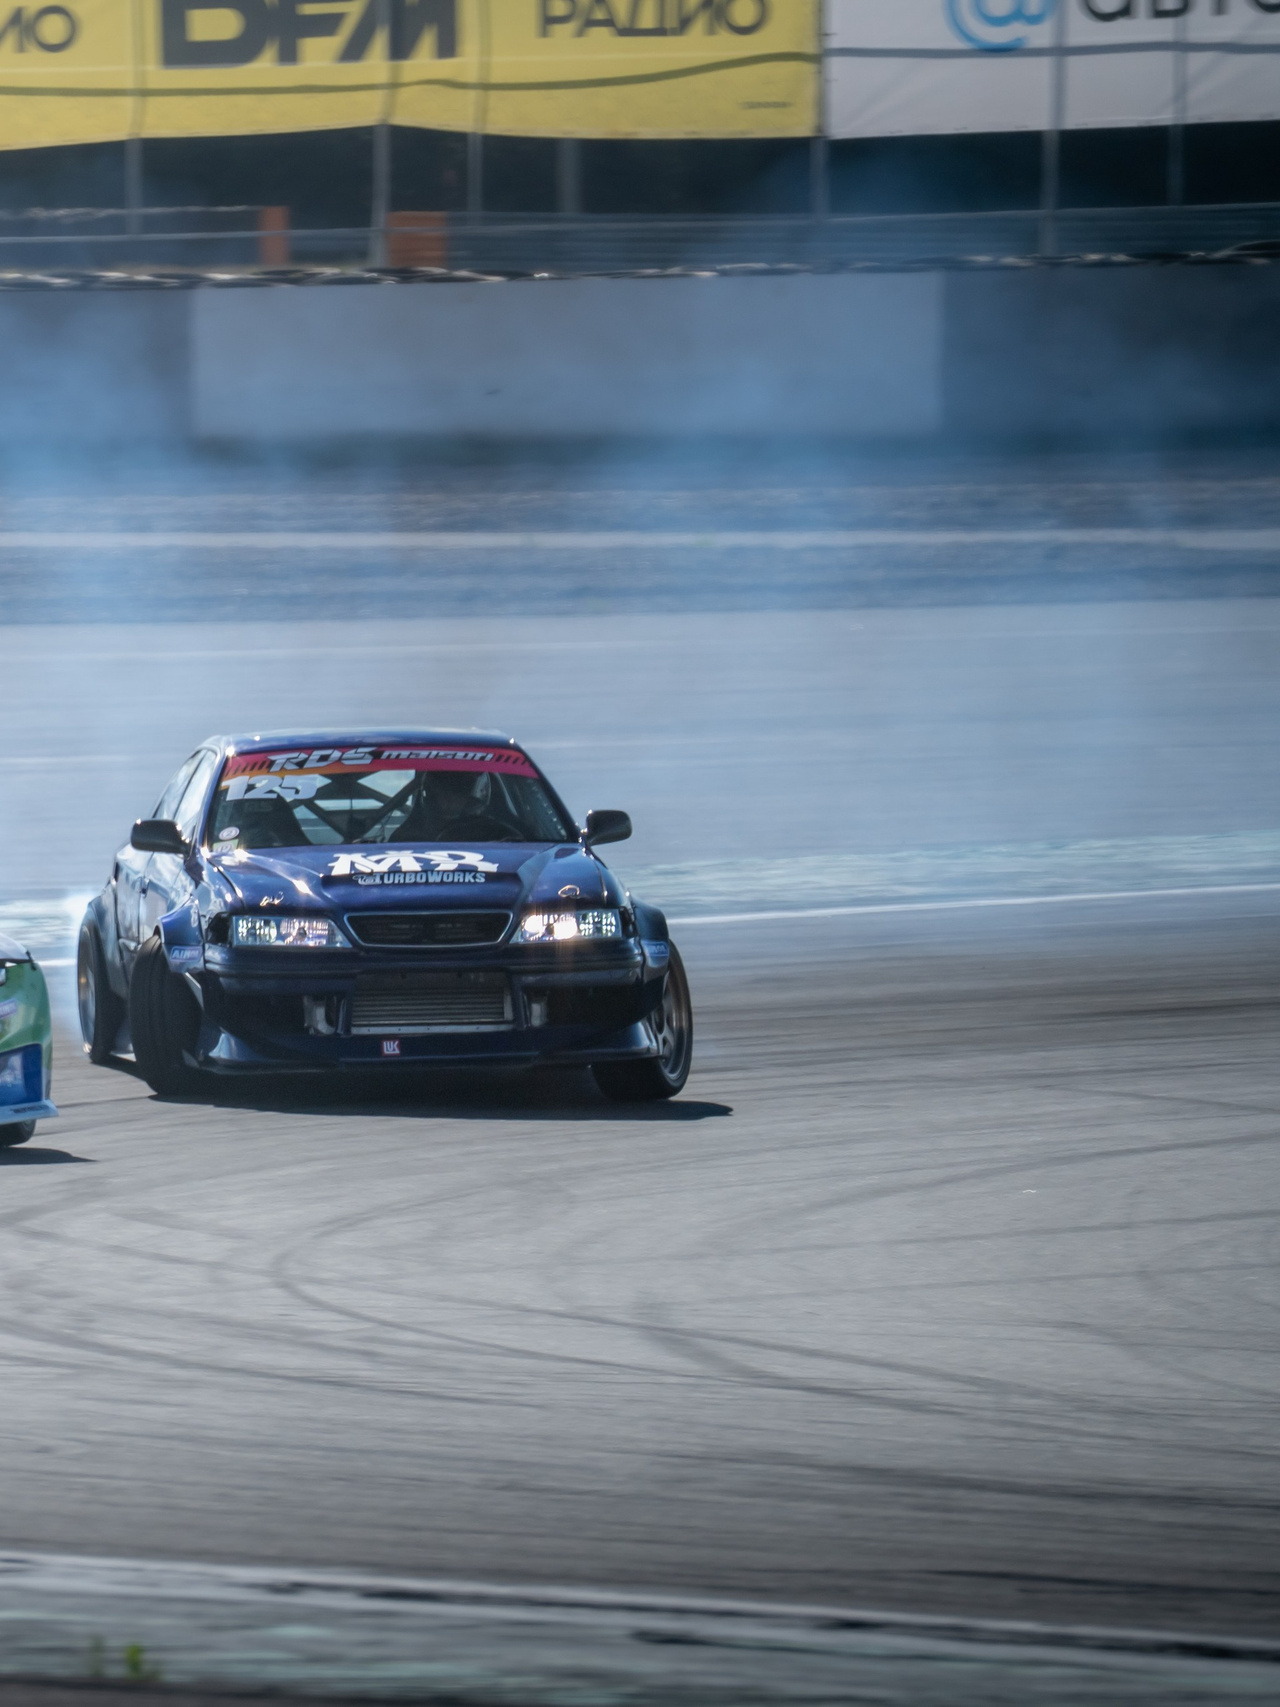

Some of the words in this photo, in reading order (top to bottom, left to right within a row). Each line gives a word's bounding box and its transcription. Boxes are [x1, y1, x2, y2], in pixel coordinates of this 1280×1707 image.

[160, 0, 458, 68] DFM
[536, 0, 772, 38] РАДИО
[267, 747, 377, 772] RDS
[222, 773, 320, 801] 125
